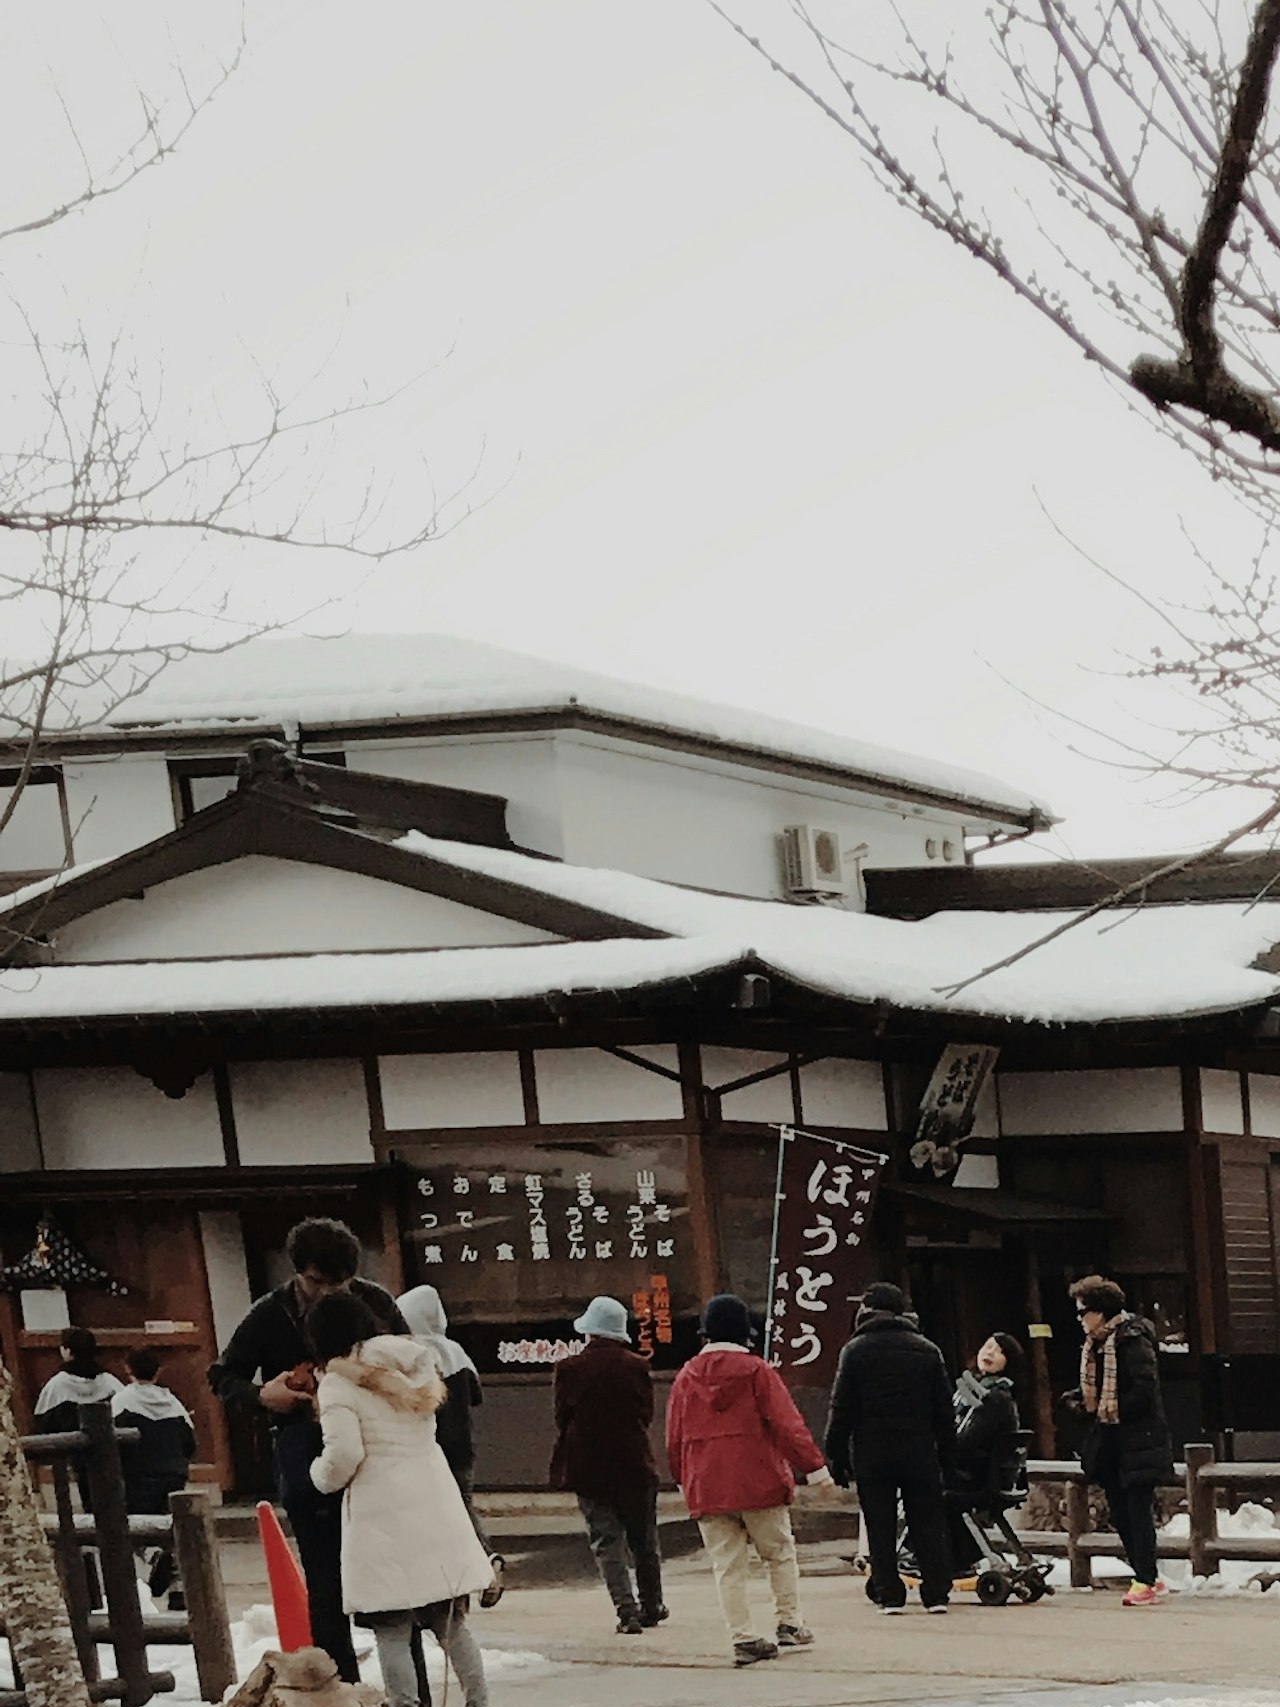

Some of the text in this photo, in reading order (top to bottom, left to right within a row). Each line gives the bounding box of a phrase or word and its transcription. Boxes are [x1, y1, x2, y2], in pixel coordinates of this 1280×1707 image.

[417, 1178, 443, 1264] もつ煮
[453, 1176, 478, 1262] おでん
[488, 1176, 515, 1262] 定食
[565, 1206, 587, 1260] うどん
[592, 1205, 613, 1259] そば
[627, 1204, 648, 1259] うどん
[654, 1204, 674, 1257] そば
[790, 1159, 853, 1366] ほうとう
